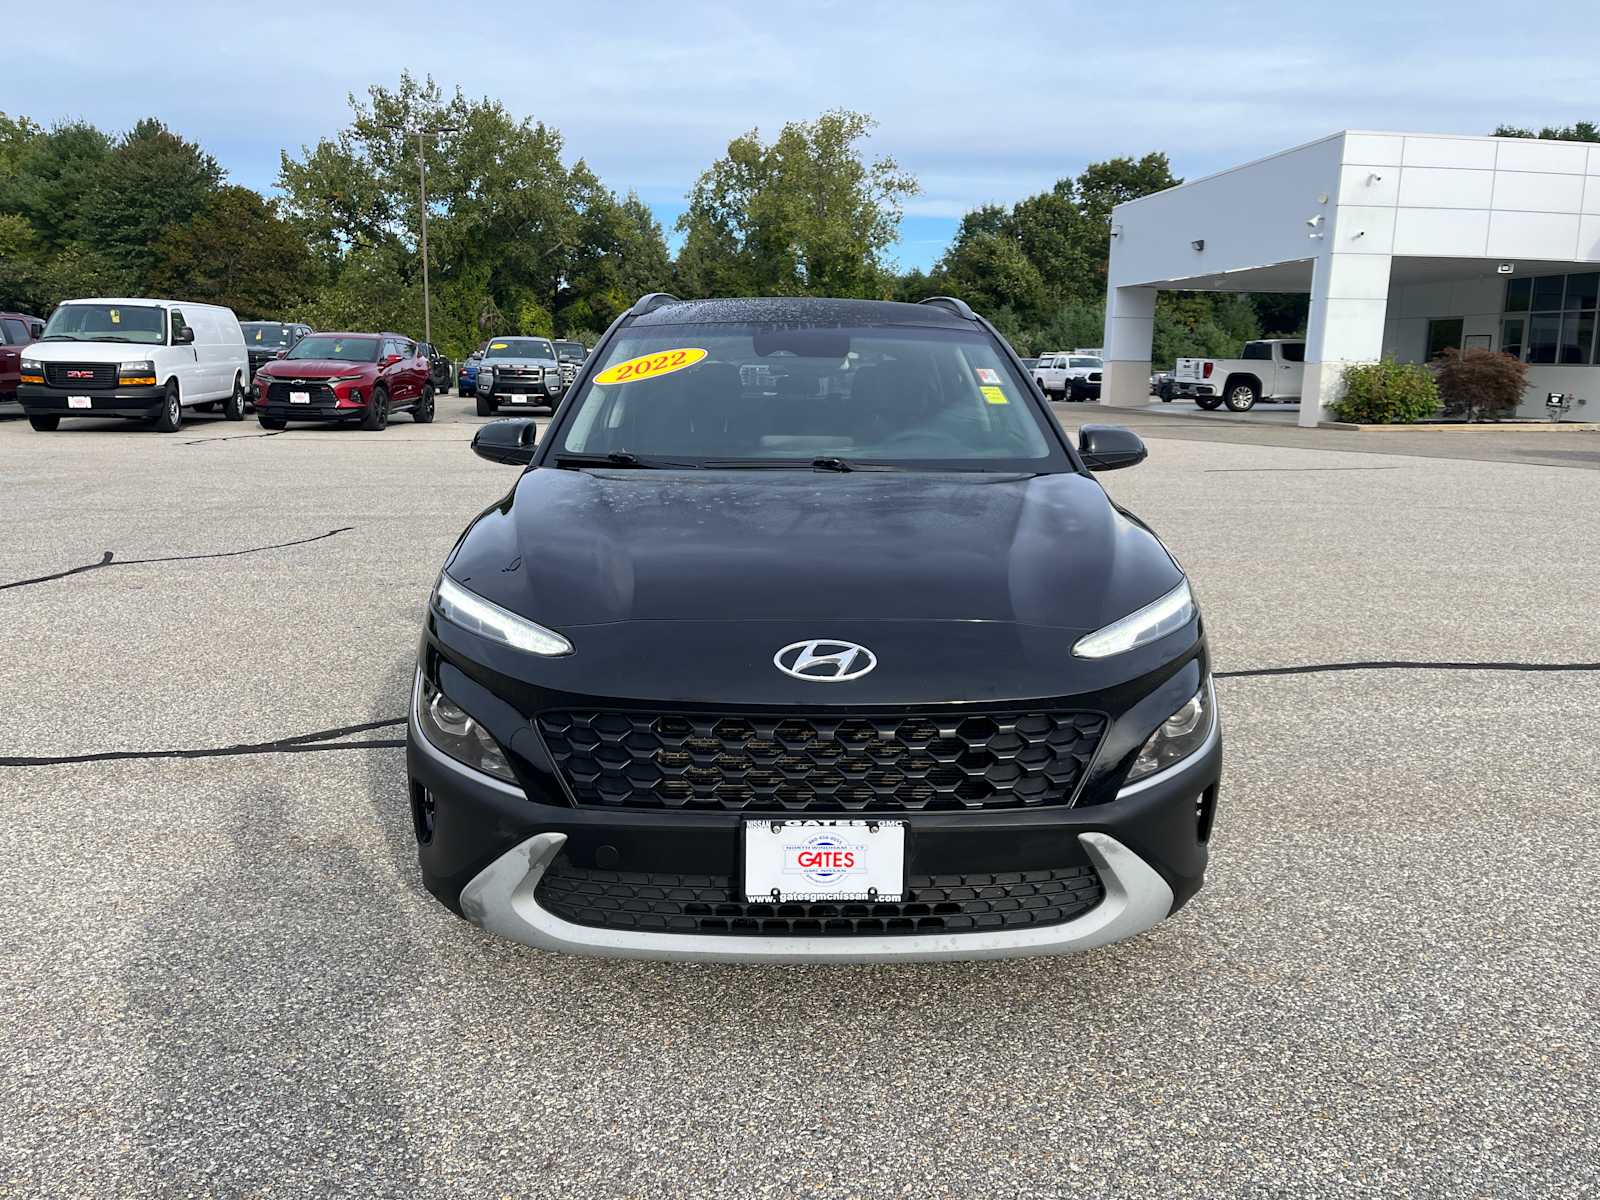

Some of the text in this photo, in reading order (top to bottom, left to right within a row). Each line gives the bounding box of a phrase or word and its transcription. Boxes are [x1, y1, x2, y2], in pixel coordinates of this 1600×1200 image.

[615, 351, 688, 381] 2022
[746, 820, 772, 828] NISSAN
[798, 851, 855, 868] GATES
